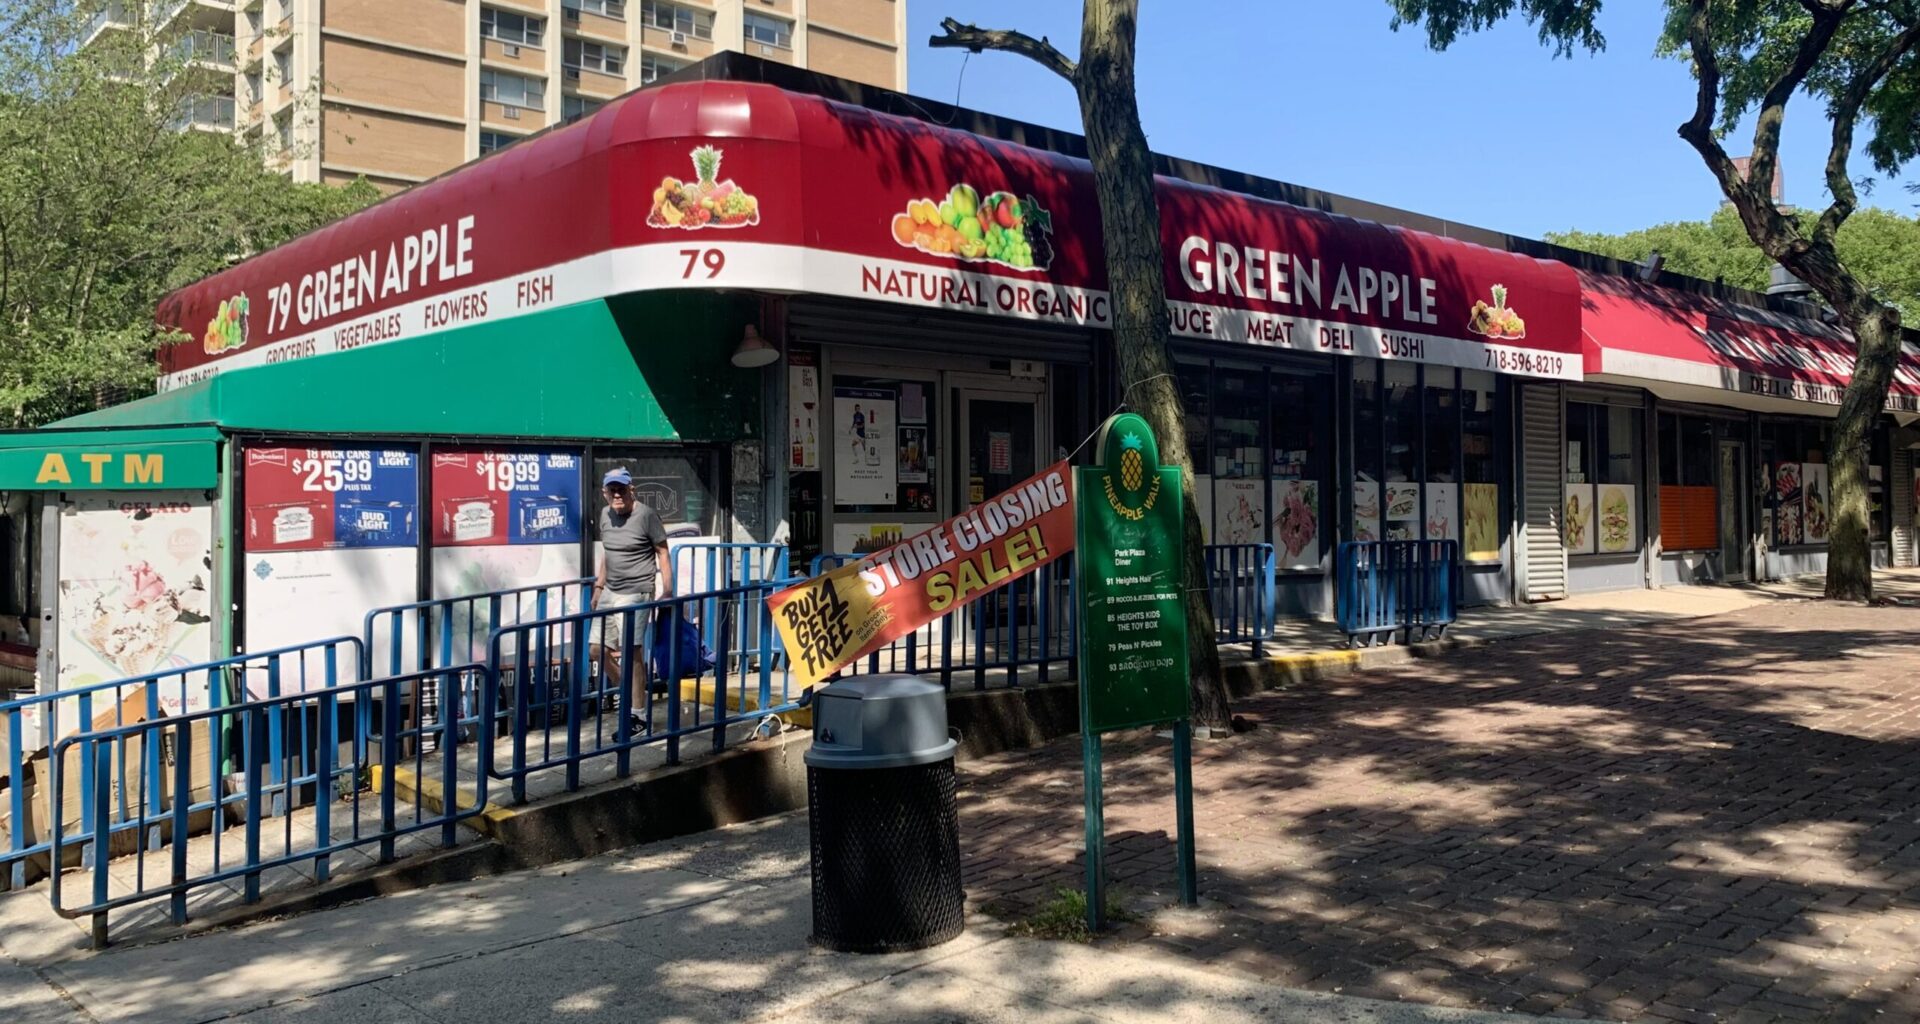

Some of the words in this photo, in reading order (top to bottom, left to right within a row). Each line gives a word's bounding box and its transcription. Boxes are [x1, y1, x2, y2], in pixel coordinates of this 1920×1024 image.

[680, 249, 725, 280] 79
[268, 282, 291, 335] 79
[297, 249, 377, 326] GREEN
[380, 215, 475, 298] APPLE
[1179, 235, 1322, 311] GREEN
[1330, 261, 1438, 325] APPLE
[862, 264, 988, 308] NATURAL
[996, 284, 1107, 323] ORGANIC
[266, 338, 316, 365] GROCERIES
[334, 314, 401, 352] VEGETABLES
[424, 290, 488, 329] FLOWERS
[517, 274, 554, 308] FISH
[1246, 318, 1294, 344] MEAT
[1320, 327, 1355, 352] DELI
[1381, 334, 1425, 360] SUSHI
[1484, 348, 1563, 376] 718-596-8219
[1750, 376, 1780, 396] DELI
[1790, 381, 1824, 400] SUSHI
[306, 449, 318, 459] 18
[321, 450, 345, 459] PACK
[350, 450, 370, 460] CANS
[383, 450, 406, 458] BUD
[484, 452, 494, 461] 12
[496, 453, 516, 462] PACK
[519, 453, 540, 462] CANS
[36, 452, 164, 484] ATM
[379, 458, 410, 466] LIGHT
[547, 460, 574, 468] LIGHT
[634, 490, 677, 511] TM
[1102, 476, 1144, 520] PINEAPPLE
[1144, 475, 1160, 510] WALK
[120, 502, 192, 514] GELATO
[537, 508, 560, 518] BUD
[362, 511, 385, 521] BUD
[532, 516, 565, 528] LIGHT
[358, 519, 389, 530] LIGHT
[859, 527, 957, 597] STORE
[952, 472, 1068, 552] CLOSING
[1115, 549, 1129, 557] Park
[1129, 548, 1145, 556] Plaza
[926, 524, 1048, 612] SALE!
[1115, 558, 1131, 566] Diner
[1116, 576, 1138, 585] Heights
[782, 587, 818, 630] BUY
[820, 578, 849, 622] 1
[863, 608, 885, 628] Grocery
[874, 616, 888, 627] Only
[1117, 612, 1144, 621] HEIGHTS
[1146, 610, 1160, 619] KIDS
[796, 603, 830, 648] GET
[1118, 623, 1130, 632] THE
[1131, 622, 1144, 630] TOY
[1145, 621, 1158, 629] BOX
[802, 610, 853, 676] FREE
[1108, 644, 1116, 652] 79
[1118, 643, 1132, 651] Peas
[1141, 640, 1162, 648] Pickles
[1119, 660, 1155, 670] BROOKLYN
